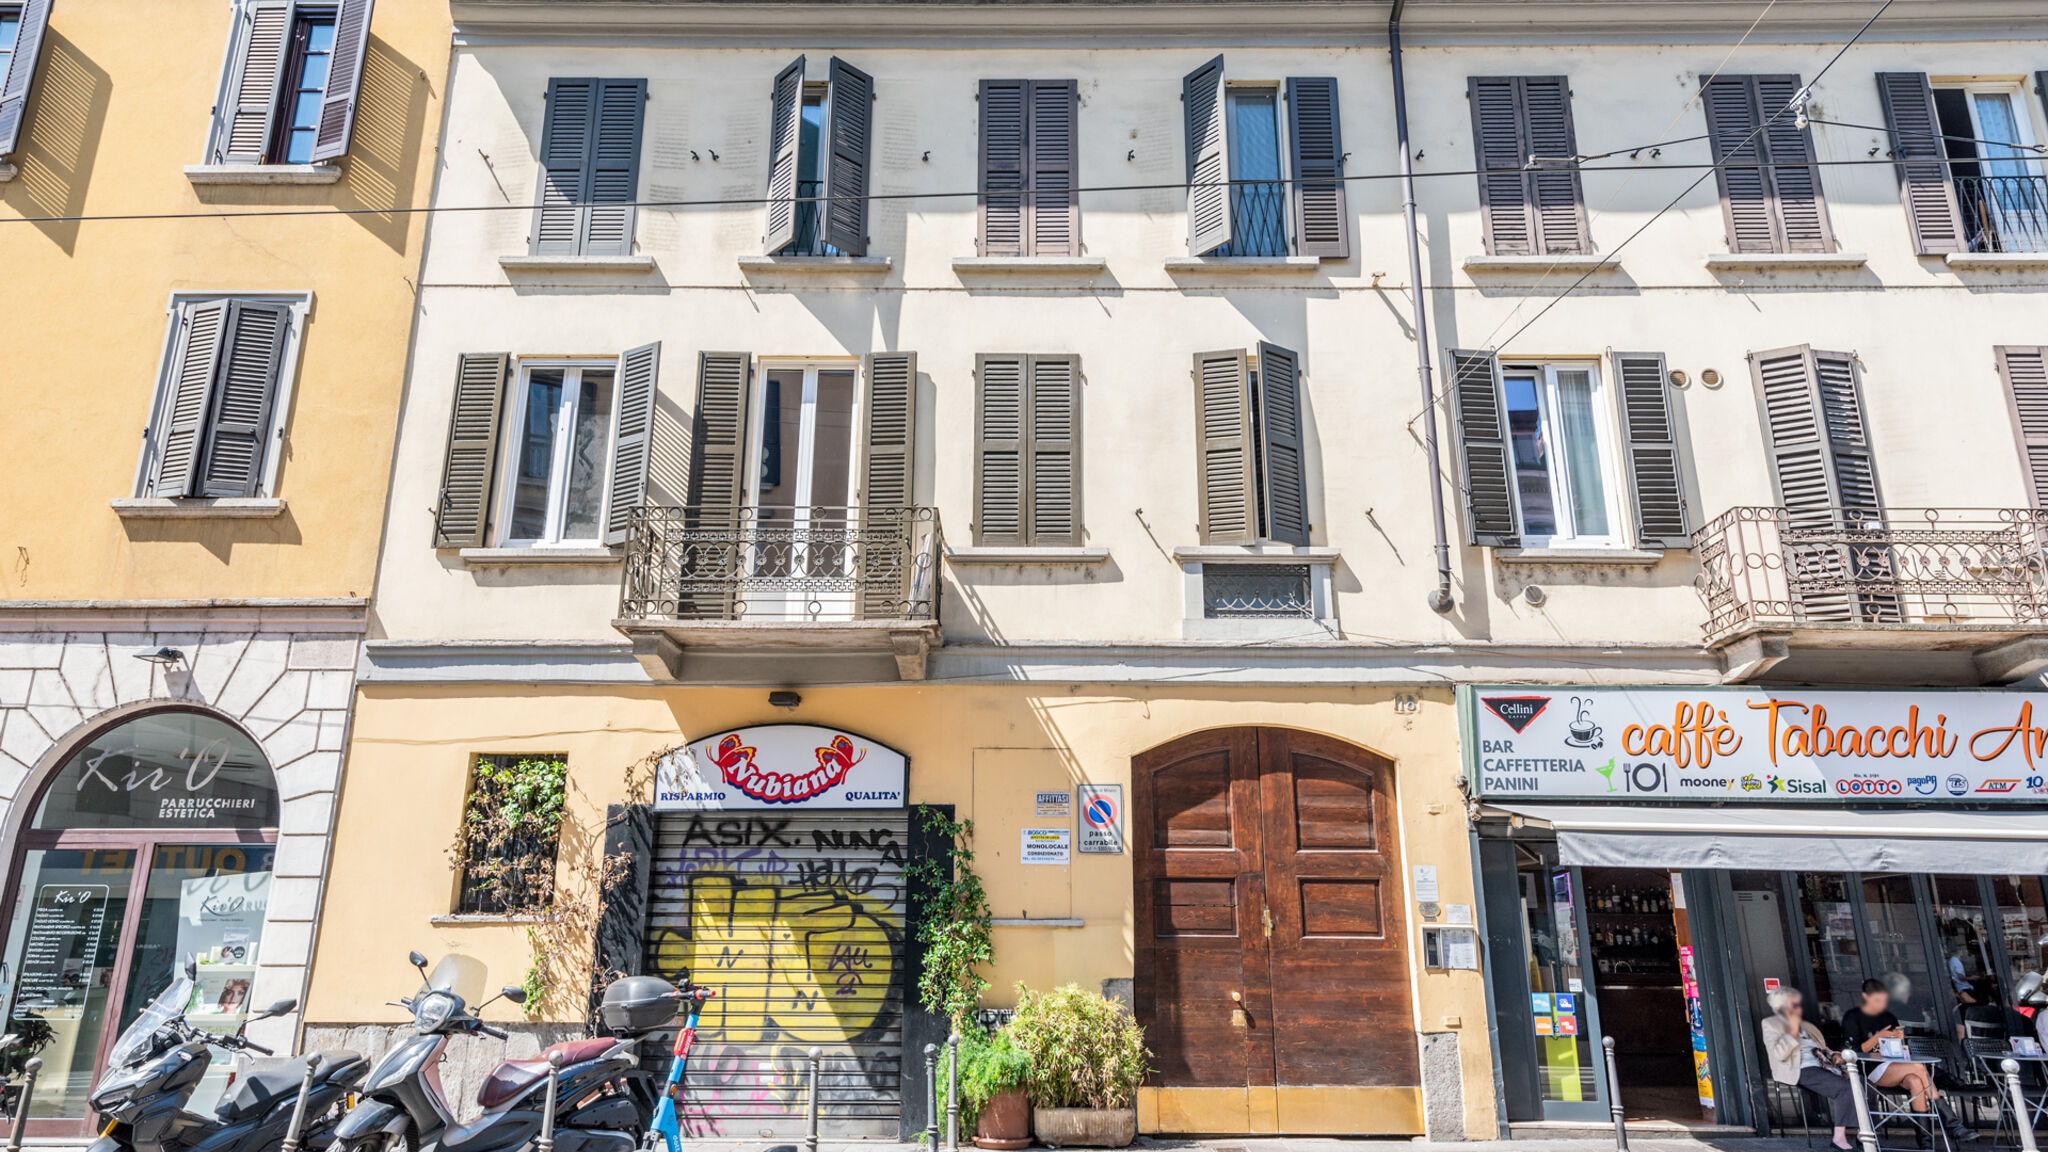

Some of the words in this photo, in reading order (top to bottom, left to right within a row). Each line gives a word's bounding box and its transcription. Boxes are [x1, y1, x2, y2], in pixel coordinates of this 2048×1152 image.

[1500, 703, 1533, 715] Cellini
[1621, 701, 1743, 769] caffè
[1746, 698, 1958, 768] Tabacchi
[1482, 740, 1514, 753] BAR
[1483, 758, 1586, 773] CAFFETTERIA
[727, 757, 842, 797] Nubiana
[1907, 775, 1937, 787] pagoPA
[2026, 775, 2044, 789] 10
[1484, 777, 1539, 791] PANINI
[1680, 778, 1735, 791] mooney
[1787, 779, 1827, 793] Sisal
[1837, 780, 1900, 794] LOTTO
[1988, 782, 2007, 790] ATM
[660, 792, 726, 801] RISPARMIO
[845, 791, 901, 801] QUALITA'
[160, 798, 256, 809] PARRUCCHIERI
[158, 808, 216, 818] ESTETICA
[1088, 830, 1113, 838] passo
